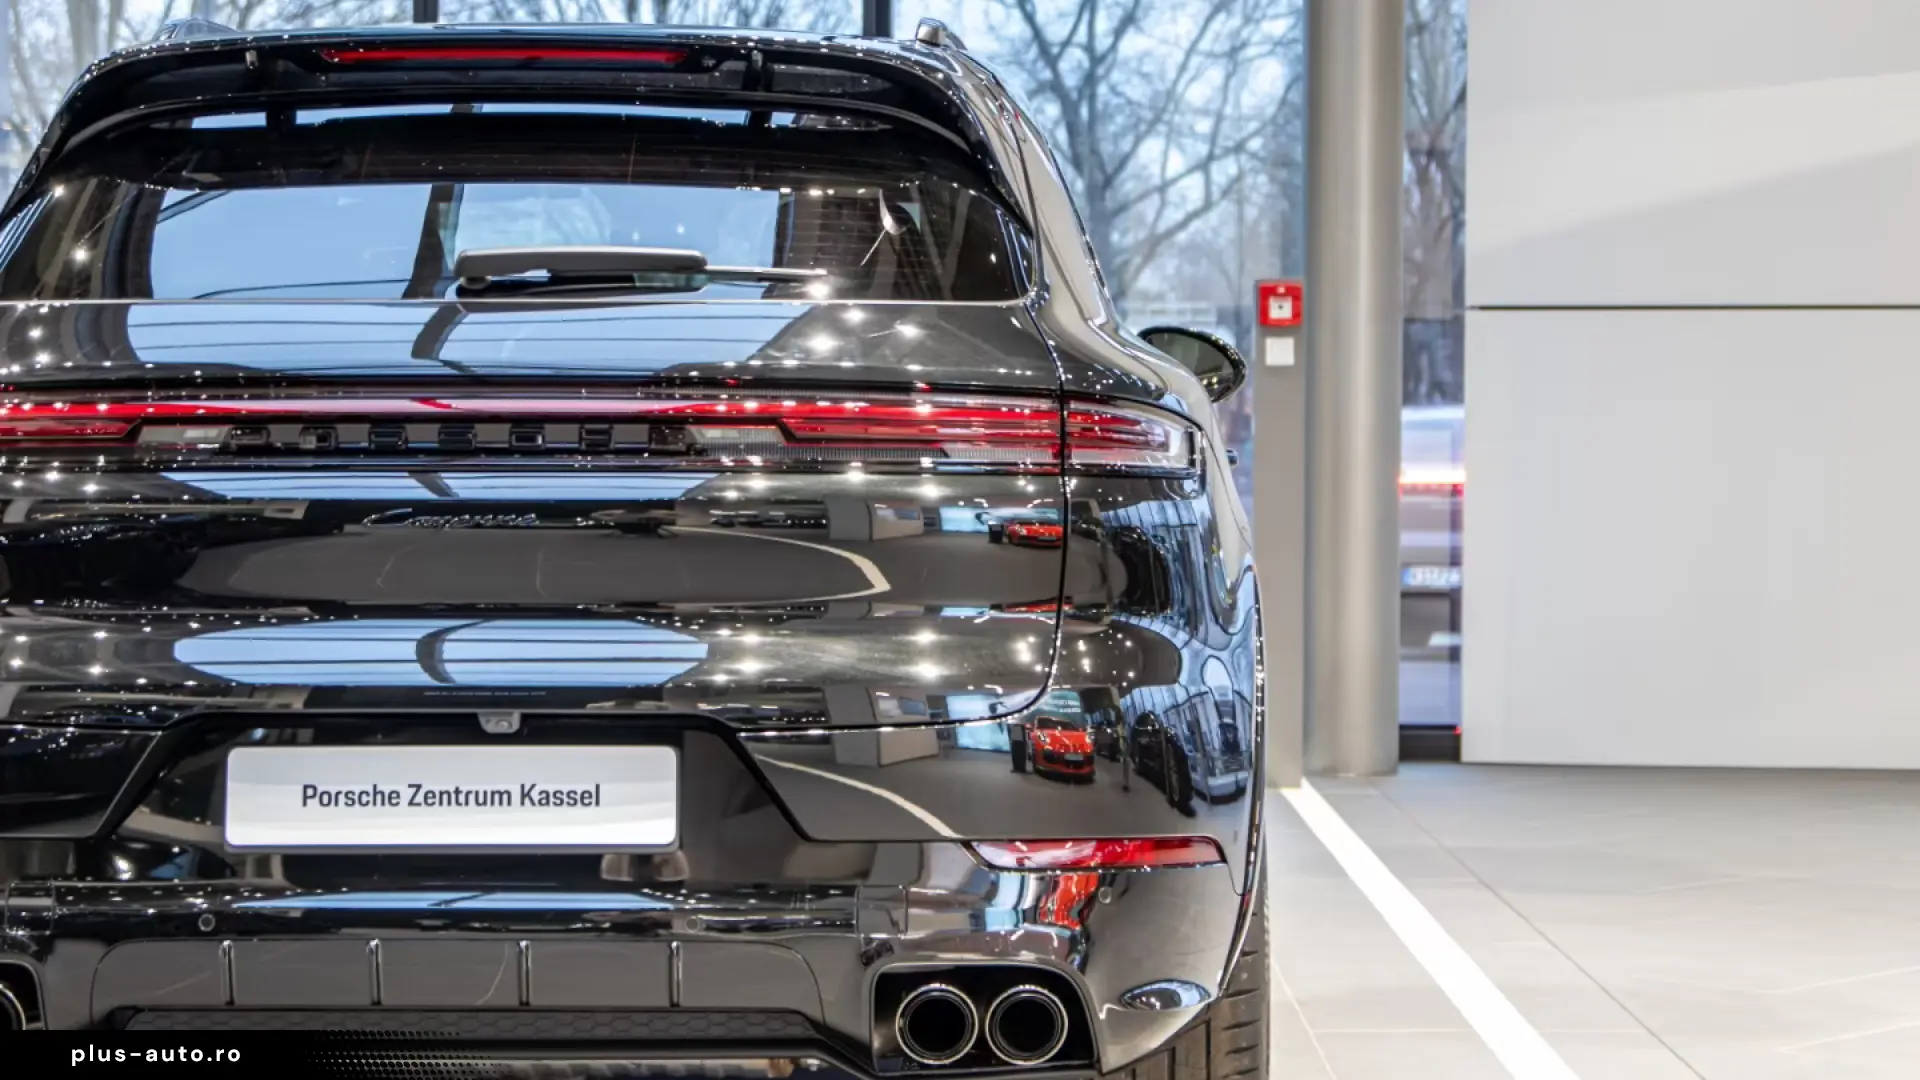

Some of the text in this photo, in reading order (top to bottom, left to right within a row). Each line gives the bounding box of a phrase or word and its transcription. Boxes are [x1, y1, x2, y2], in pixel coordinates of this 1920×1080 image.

[361, 507, 541, 531] Cayenne
[301, 783, 601, 808] Porsche Zentrum Kassel
